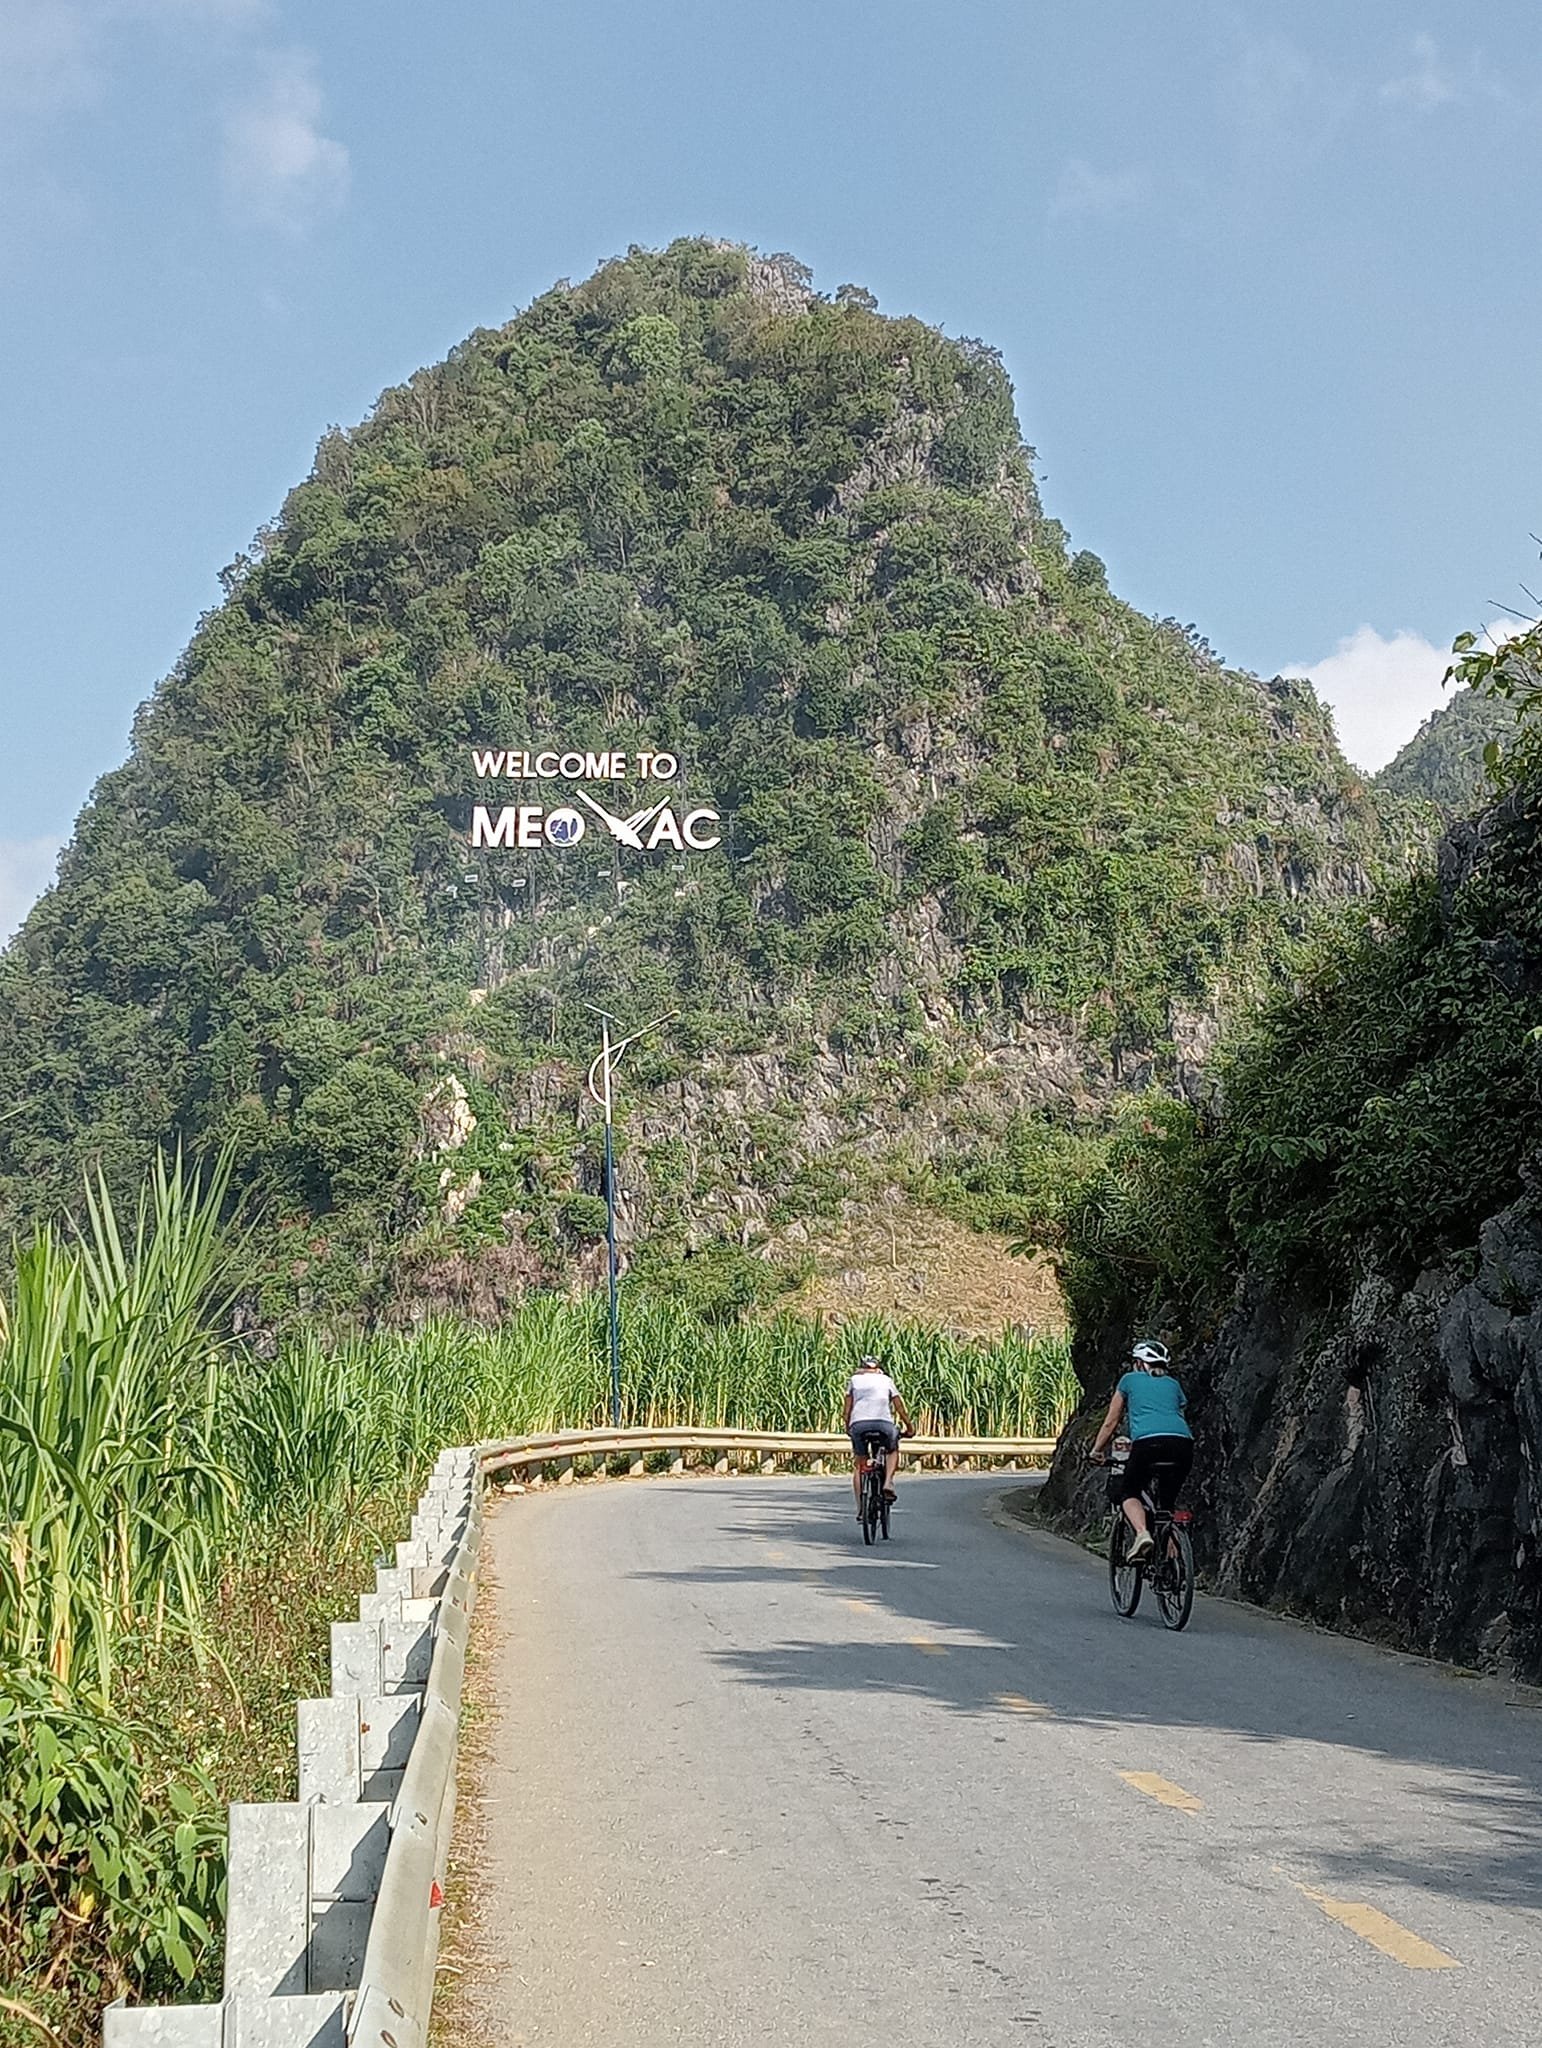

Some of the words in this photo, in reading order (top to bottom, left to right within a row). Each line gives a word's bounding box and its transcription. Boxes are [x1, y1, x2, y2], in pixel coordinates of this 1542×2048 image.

[472, 752, 626, 778] WELCOME
[637, 752, 678, 779] TO
[472, 806, 586, 848] MEO
